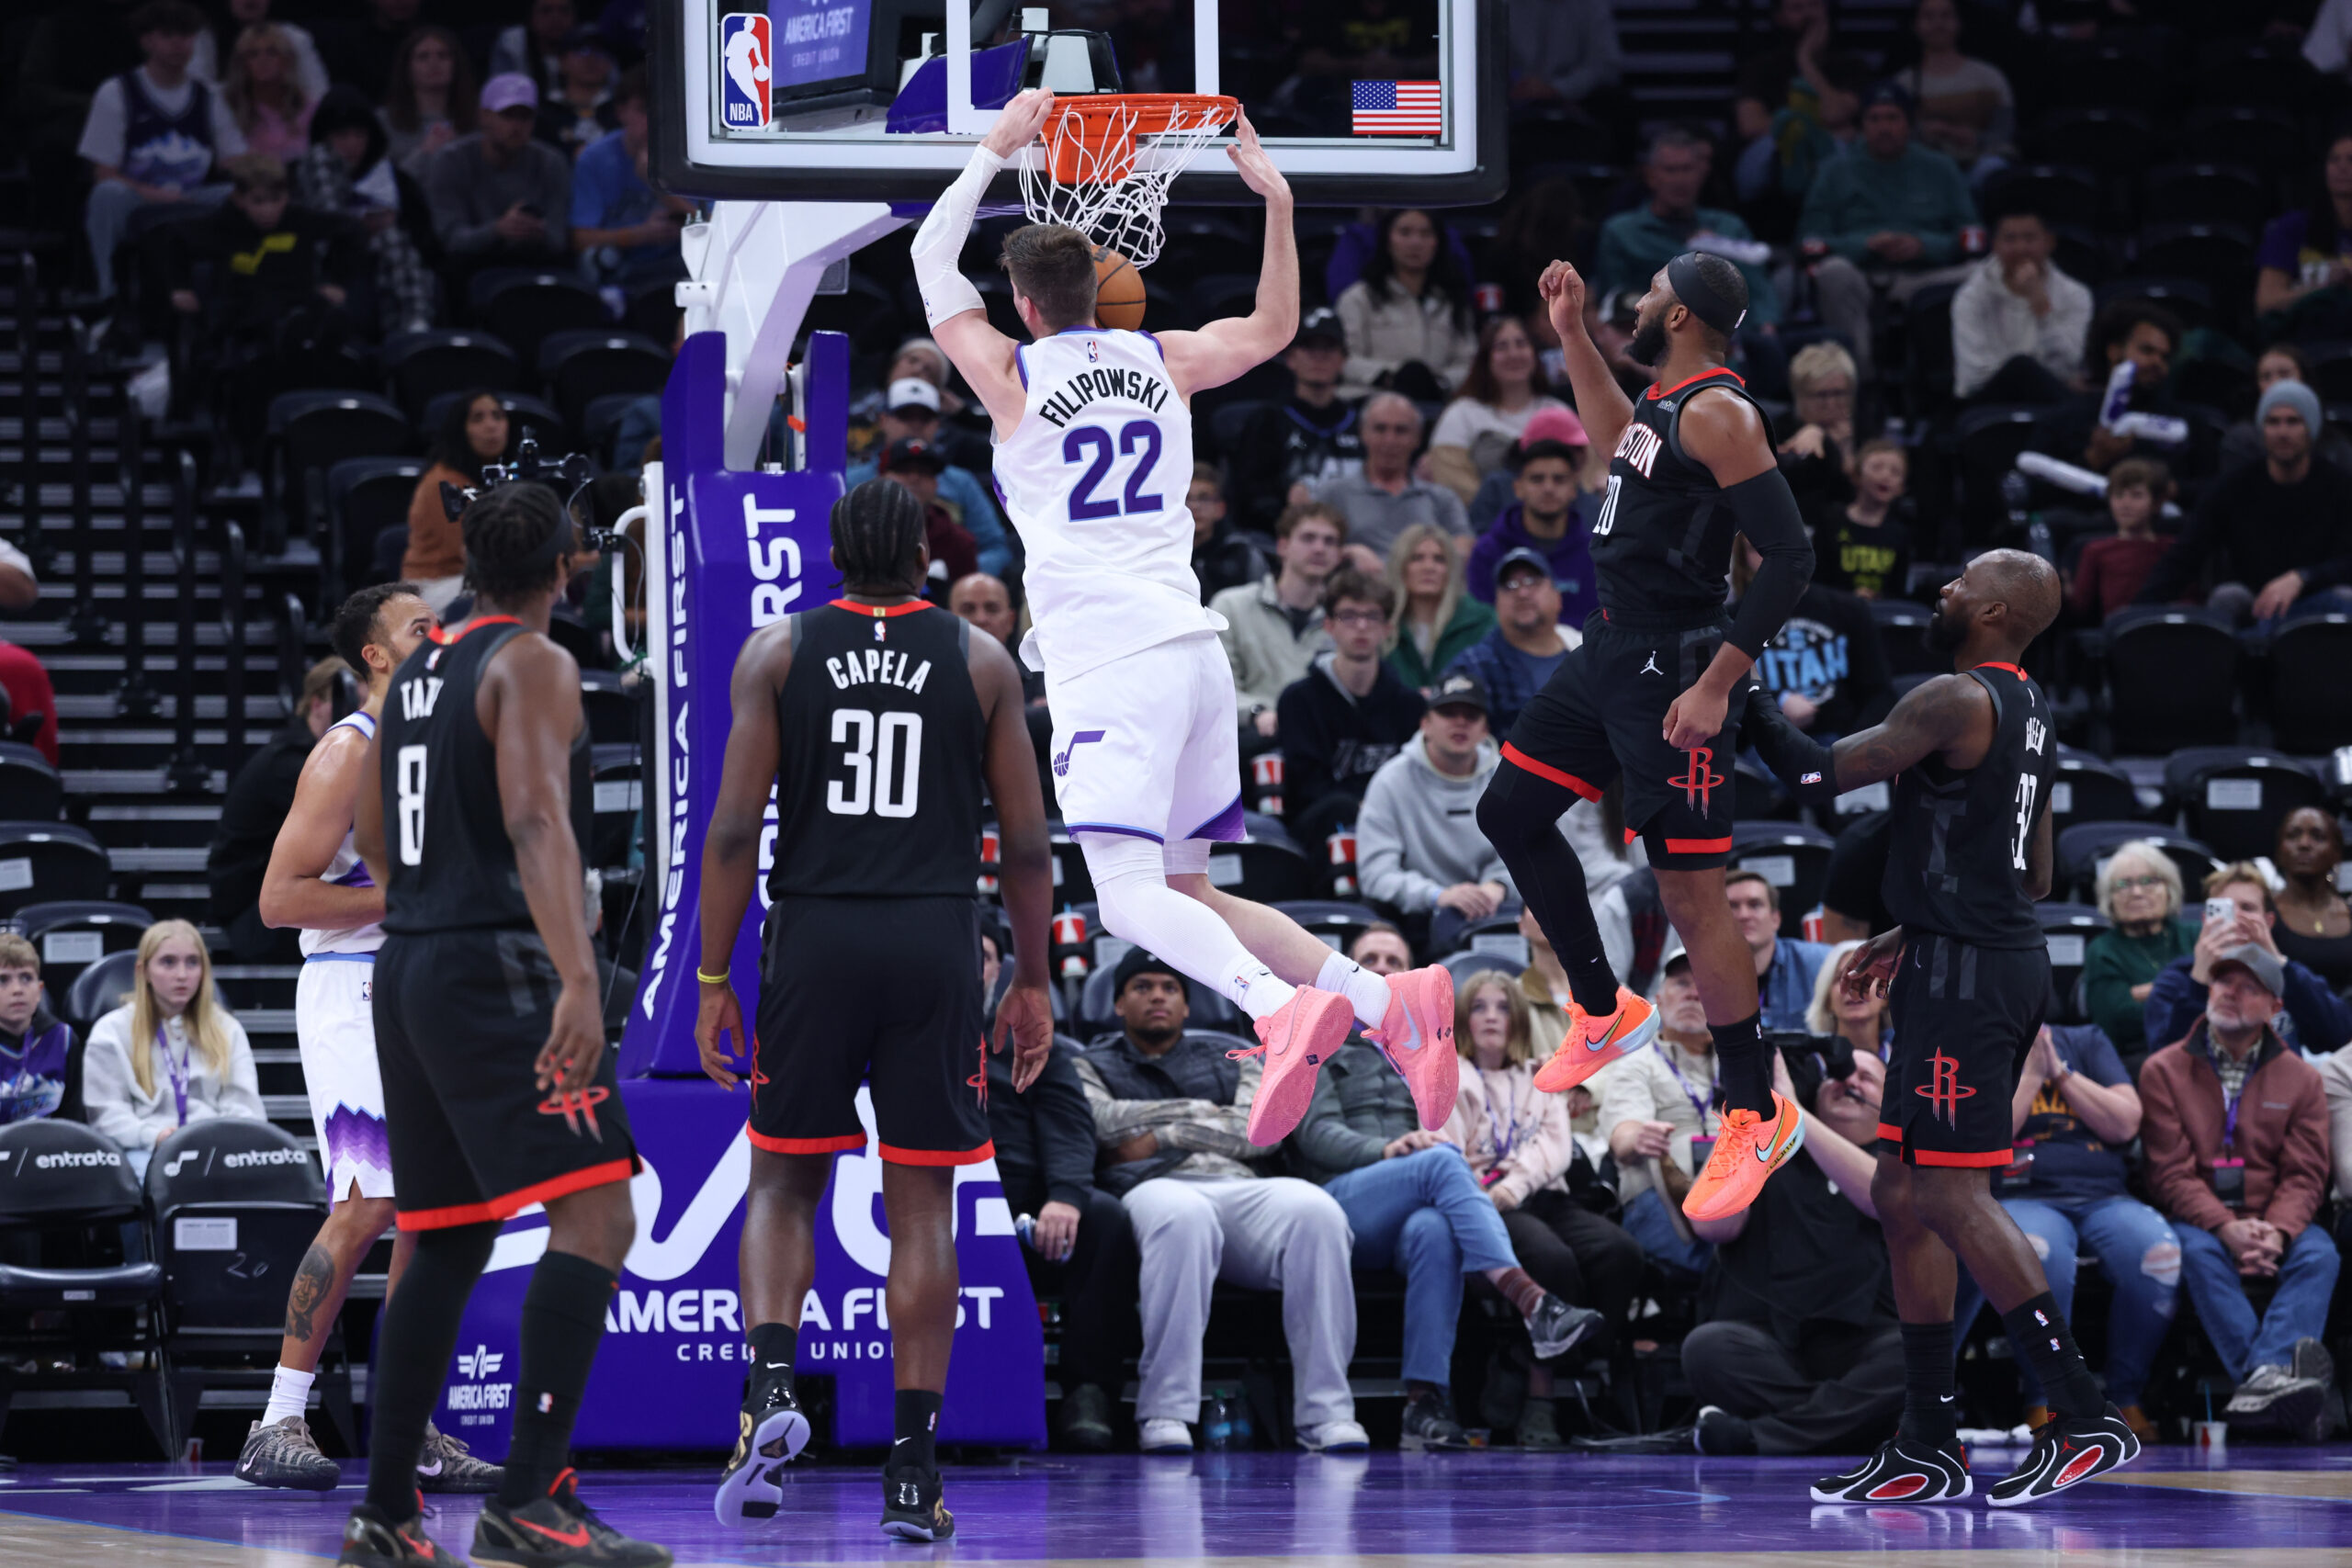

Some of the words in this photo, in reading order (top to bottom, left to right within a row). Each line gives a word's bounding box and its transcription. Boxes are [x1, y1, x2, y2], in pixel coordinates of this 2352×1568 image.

[784, 12, 826, 45] AMERICA
[826, 7, 854, 38] FIRST
[729, 103, 753, 121] NBA
[1039, 368, 1169, 428] FILIPOWSKI
[1062, 419, 1164, 523] 22
[1592, 475, 1622, 536] 20
[742, 492, 802, 628] RST
[826, 649, 932, 694] CAPELA
[641, 701, 689, 1021] AMERICA
[670, 483, 689, 688] FIRST
[827, 708, 923, 818] 30
[398, 744, 428, 866] 8
[35, 1149, 121, 1168] entrata
[223, 1147, 308, 1168] entrata
[604, 1288, 832, 1333] MERA
[842, 1286, 1005, 1331] FIT
[810, 1341, 893, 1360] UNIO
[447, 1384, 484, 1410] AMERICA
[483, 1382, 513, 1409] FIRST
